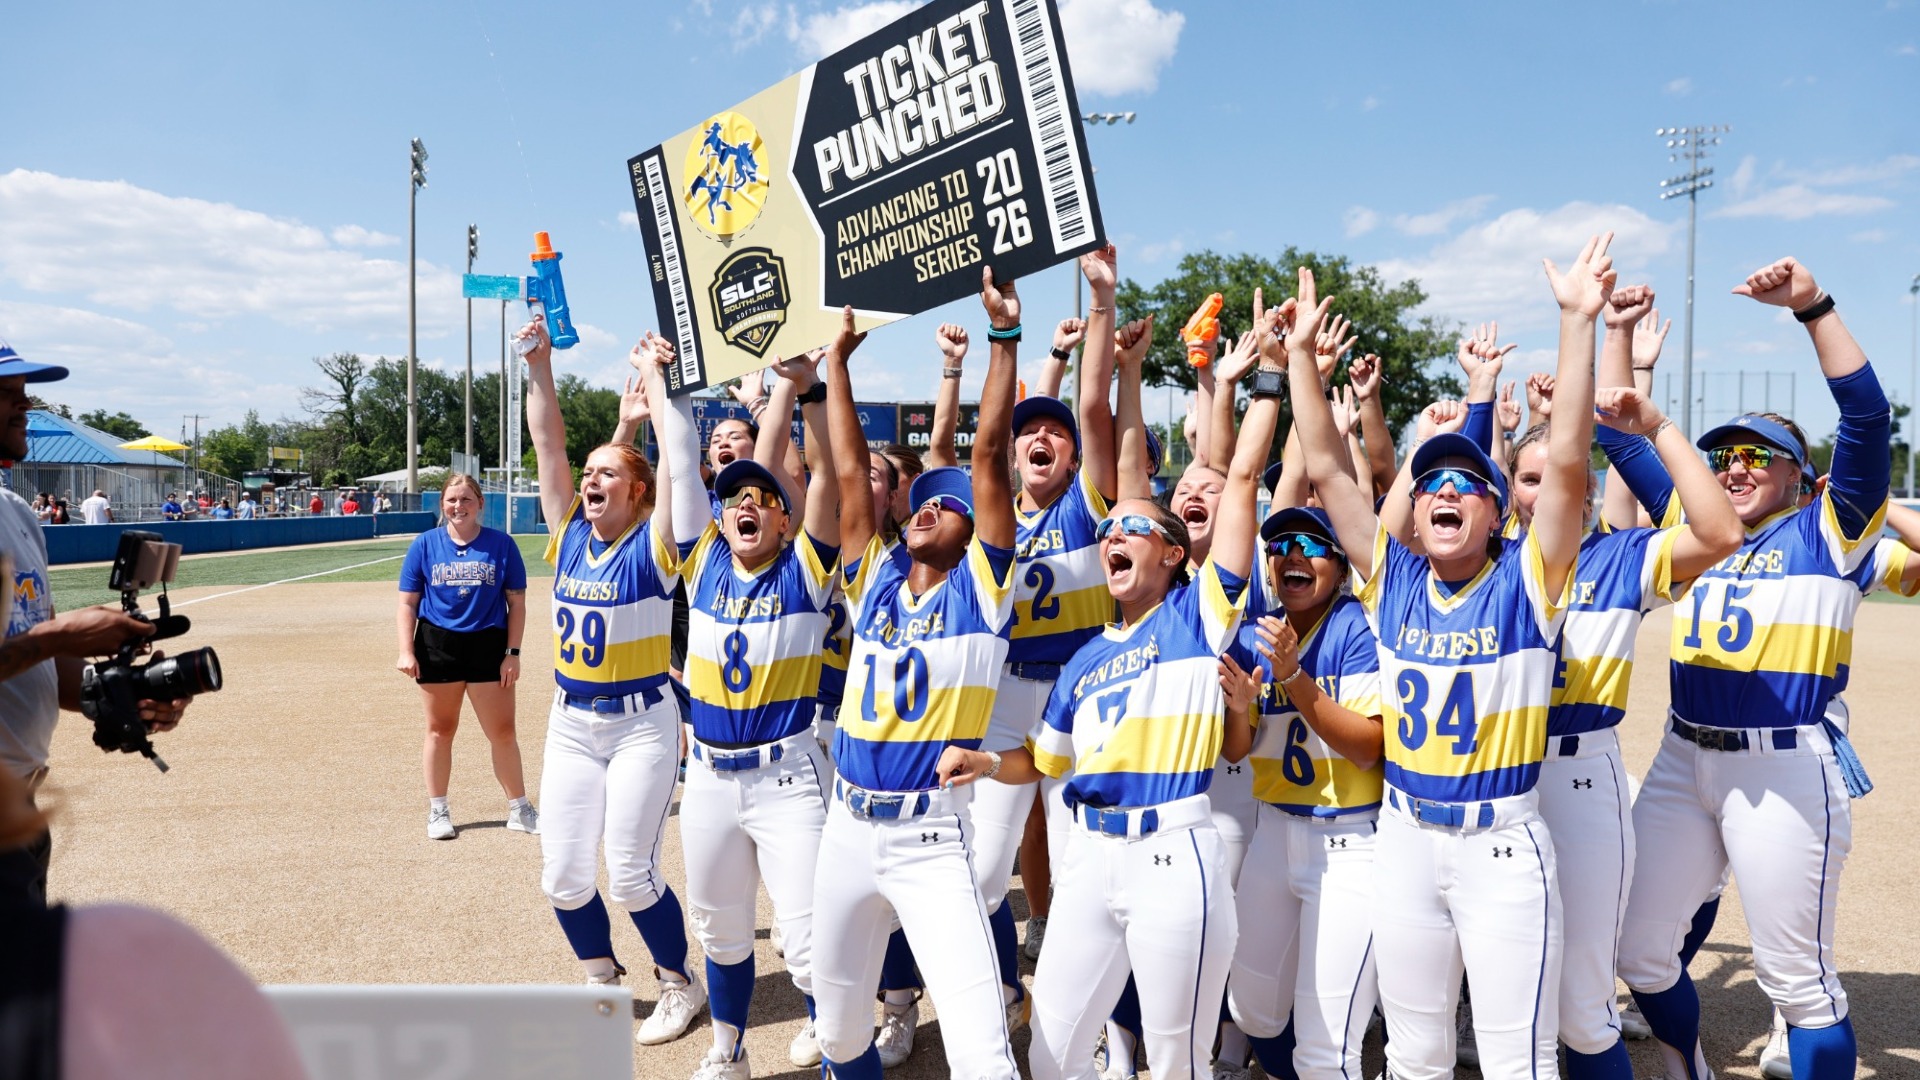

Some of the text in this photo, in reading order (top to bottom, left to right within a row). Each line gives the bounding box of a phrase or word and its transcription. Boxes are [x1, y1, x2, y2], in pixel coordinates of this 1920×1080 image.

[843, 0, 990, 119] TICKET
[813, 60, 1006, 193] PUNCHED
[634, 176, 647, 199] SEAT
[976, 147, 1023, 206] 20
[837, 169, 969, 248] ADVANCING TO
[986, 198, 1033, 255] 26
[836, 201, 974, 279] CHAMPIONSHIP
[913, 234, 982, 283] SERIES
[652, 261, 664, 282] ROW
[720, 271, 773, 307] SLC
[724, 289, 775, 315] SOUTHLAND
[731, 313, 778, 334] CHAMPIONSHIP
[736, 304, 768, 320] SOFTBALL
[669, 354, 681, 390] SECTIO
[692, 400, 708, 408] BALL
[697, 407, 704, 418] 0
[728, 407, 735, 419] 0
[1013, 562, 1060, 626] 2
[1683, 582, 1754, 653] 15
[556, 606, 606, 668] 29
[723, 629, 753, 694] 8
[860, 646, 929, 723] 10
[1397, 667, 1479, 756] 34
[1093, 685, 1132, 754] 7
[1282, 716, 1316, 787] 6
